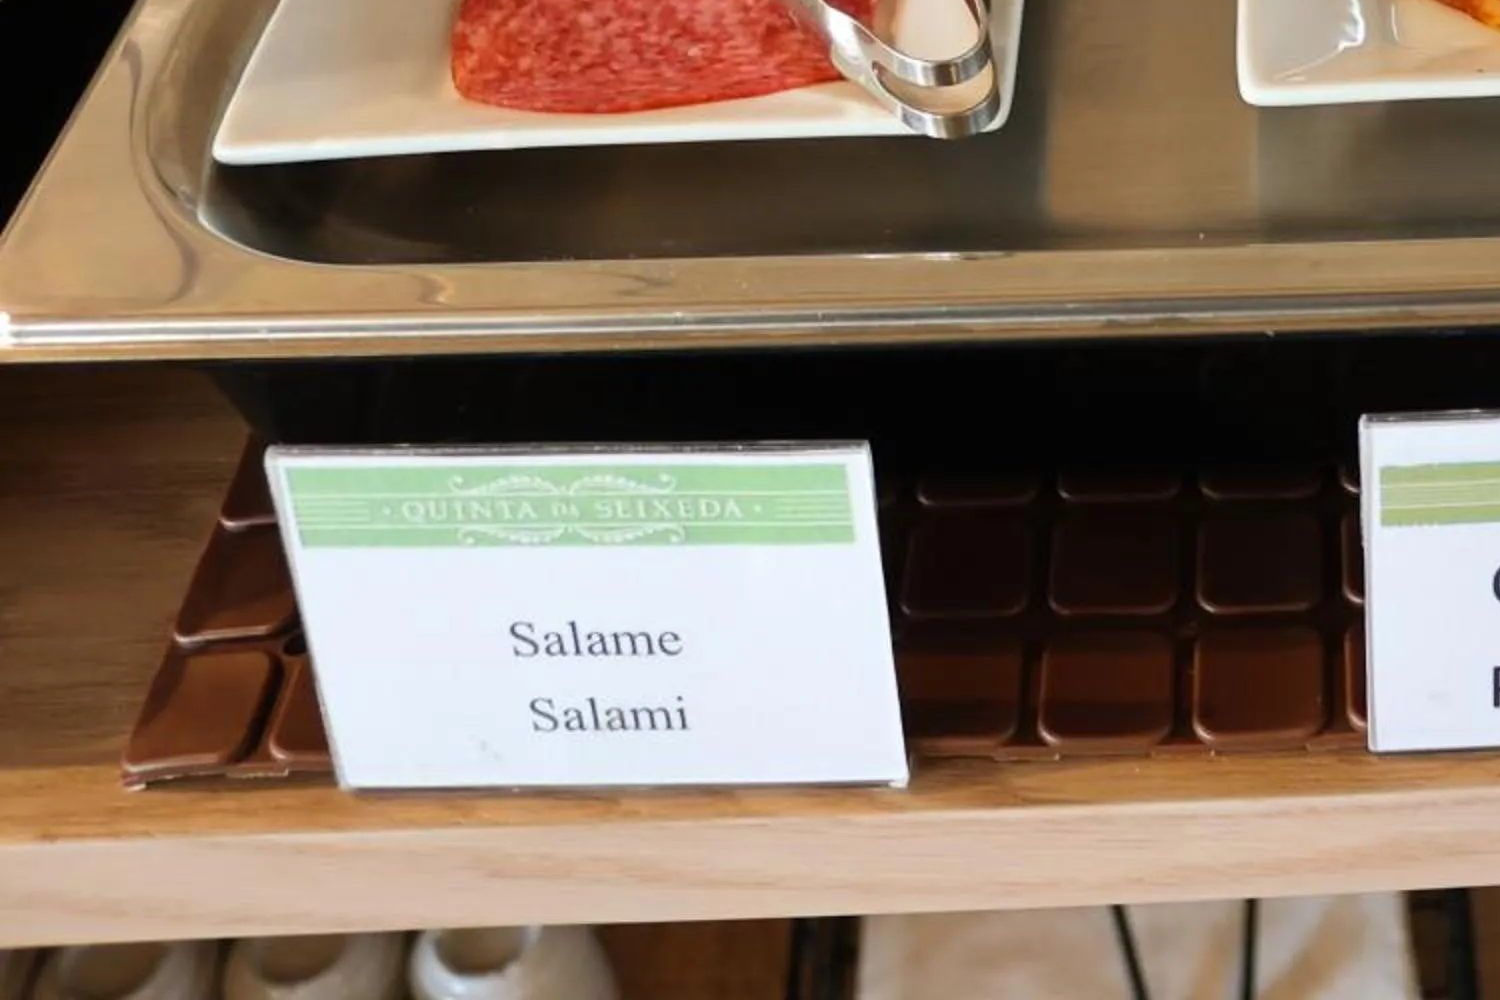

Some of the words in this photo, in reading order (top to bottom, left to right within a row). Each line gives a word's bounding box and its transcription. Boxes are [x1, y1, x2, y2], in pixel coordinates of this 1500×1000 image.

[402, 499, 538, 525] QUINTA
[594, 497, 745, 520] SEIXEDA
[508, 619, 684, 658] Salame
[528, 695, 690, 733] Salami
